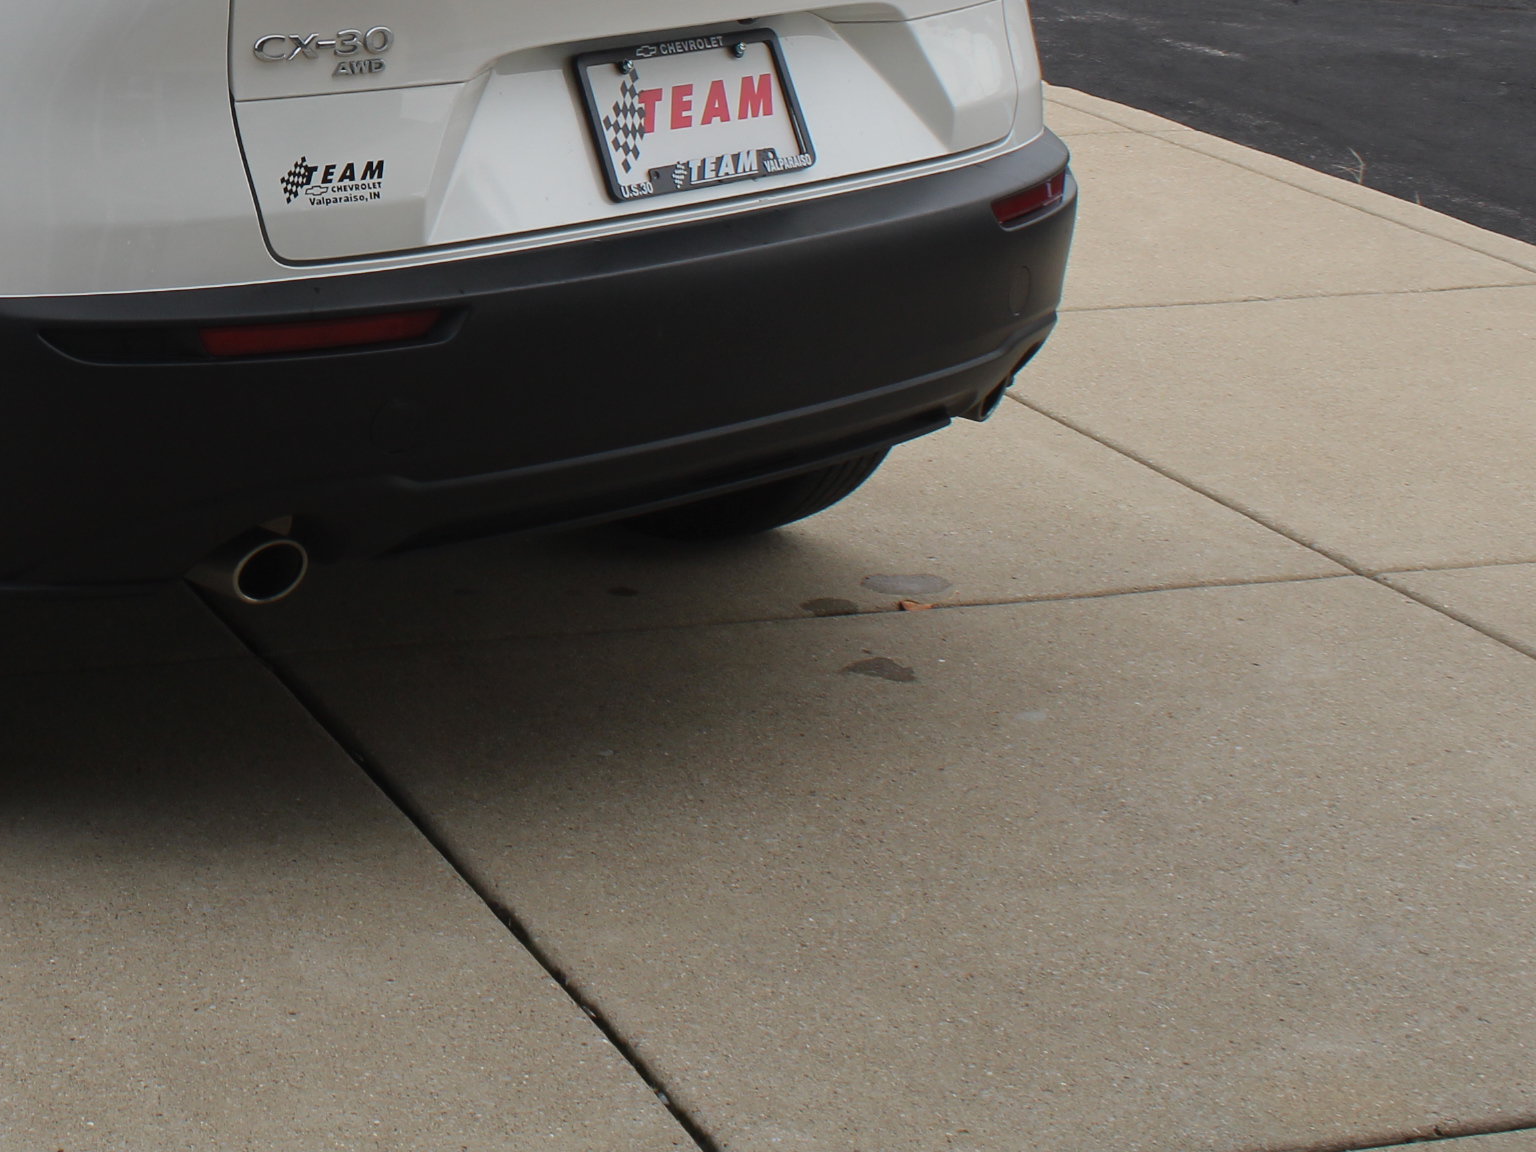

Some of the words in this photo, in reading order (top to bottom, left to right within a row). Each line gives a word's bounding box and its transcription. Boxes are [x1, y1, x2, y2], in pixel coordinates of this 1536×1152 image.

[253, 24, 395, 62] CX-30
[659, 35, 724, 55] CHEVROLET
[331, 58, 386, 78] AWD
[638, 72, 774, 134] TEAM
[304, 159, 385, 186] TEAM
[688, 149, 759, 183] TEAM
[763, 153, 813, 173] VALPARAISO
[331, 181, 382, 193] CHEVROLET
[308, 193, 369, 207] Valparaiso,
[369, 191, 381, 200] IN
